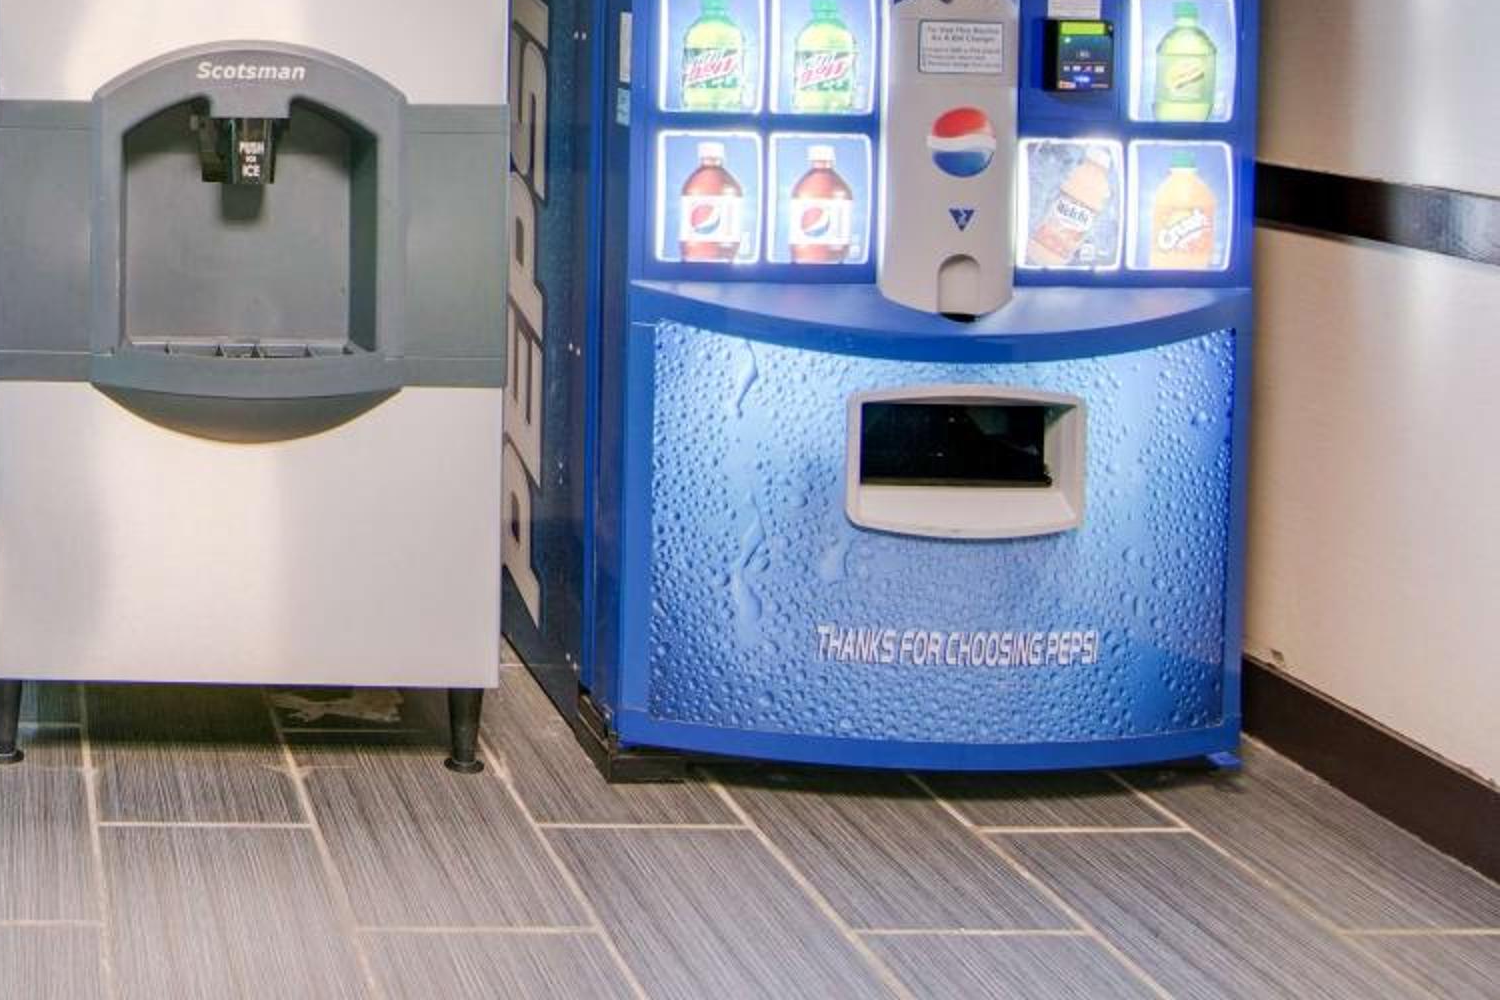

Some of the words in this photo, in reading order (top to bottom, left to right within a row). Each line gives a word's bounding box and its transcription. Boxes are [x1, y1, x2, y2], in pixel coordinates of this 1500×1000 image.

[195, 61, 307, 81] Scotsman
[242, 164, 261, 177] ICE
[817, 625, 897, 664] THANKS
[900, 631, 940, 665] FOR
[945, 631, 1045, 667] CHOOSING
[1045, 630, 1100, 665] PEPSI
